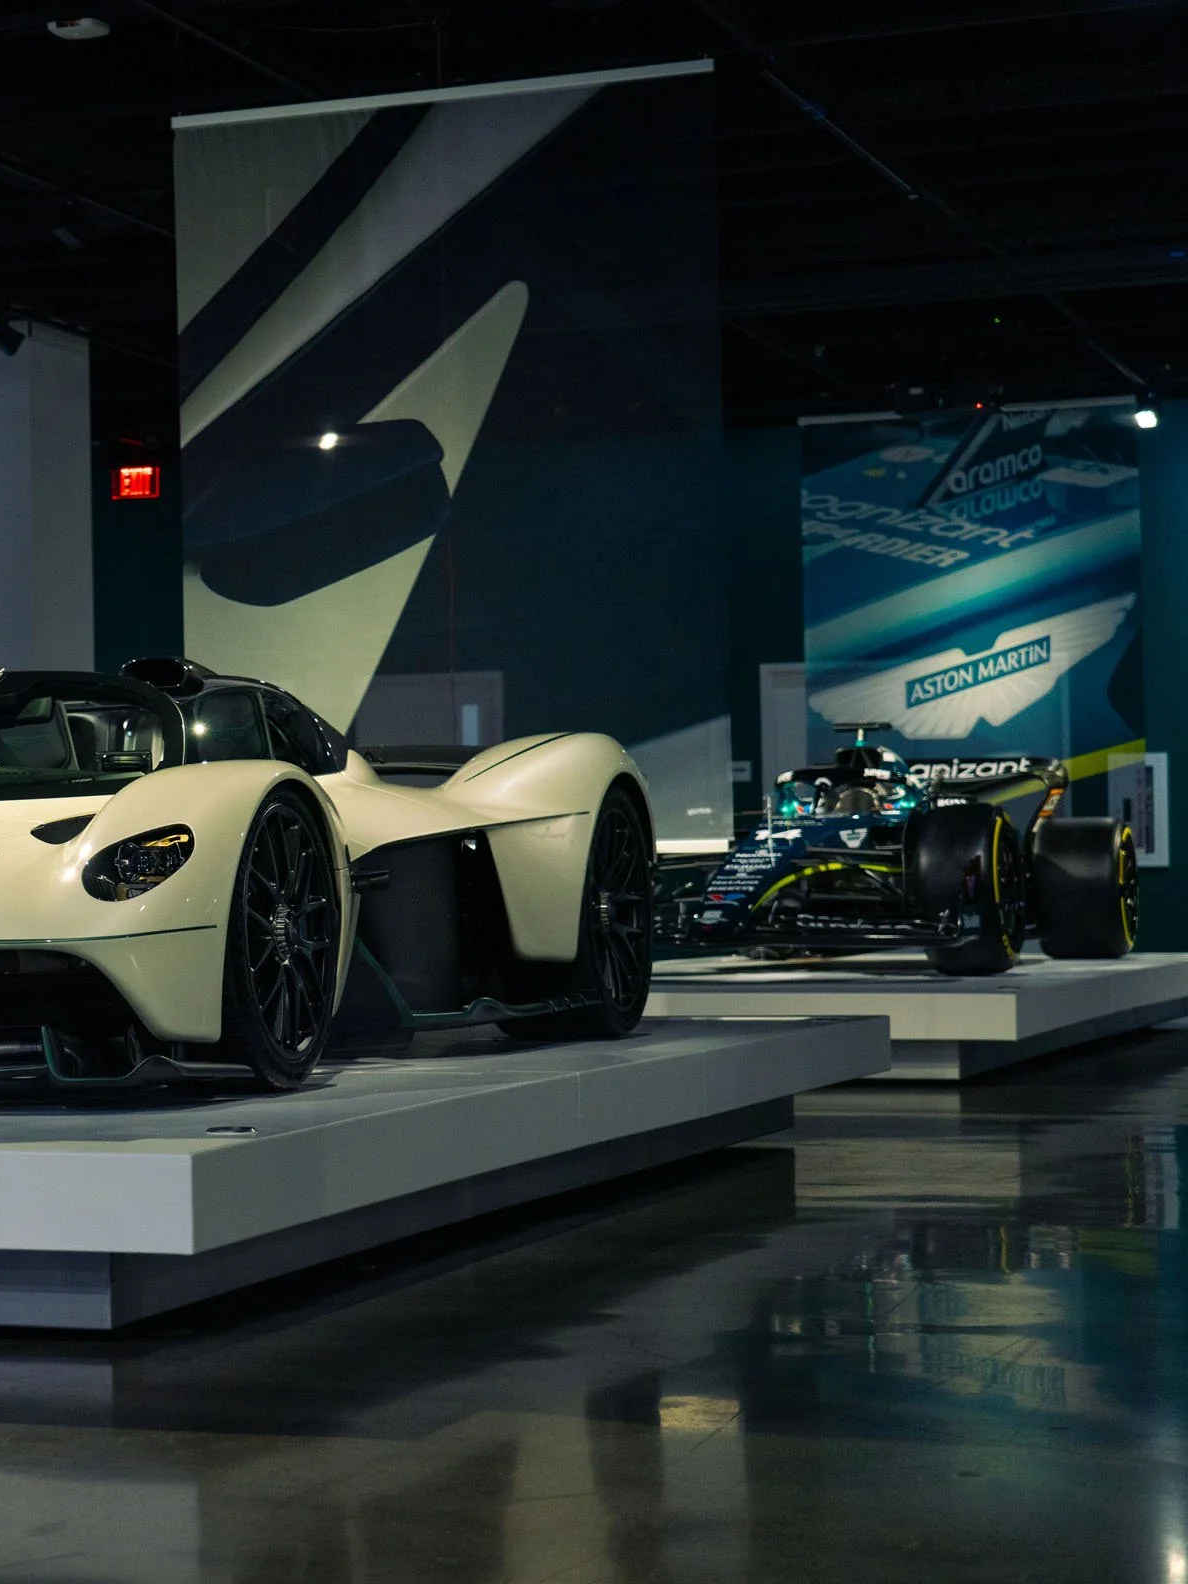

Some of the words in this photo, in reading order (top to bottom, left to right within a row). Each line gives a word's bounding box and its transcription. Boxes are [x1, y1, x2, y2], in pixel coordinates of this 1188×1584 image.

[948, 443, 1043, 494] aramco
[801, 489, 1034, 548] ognizant
[911, 664, 973, 702] ASTON
[977, 641, 1047, 681] MARTIN
